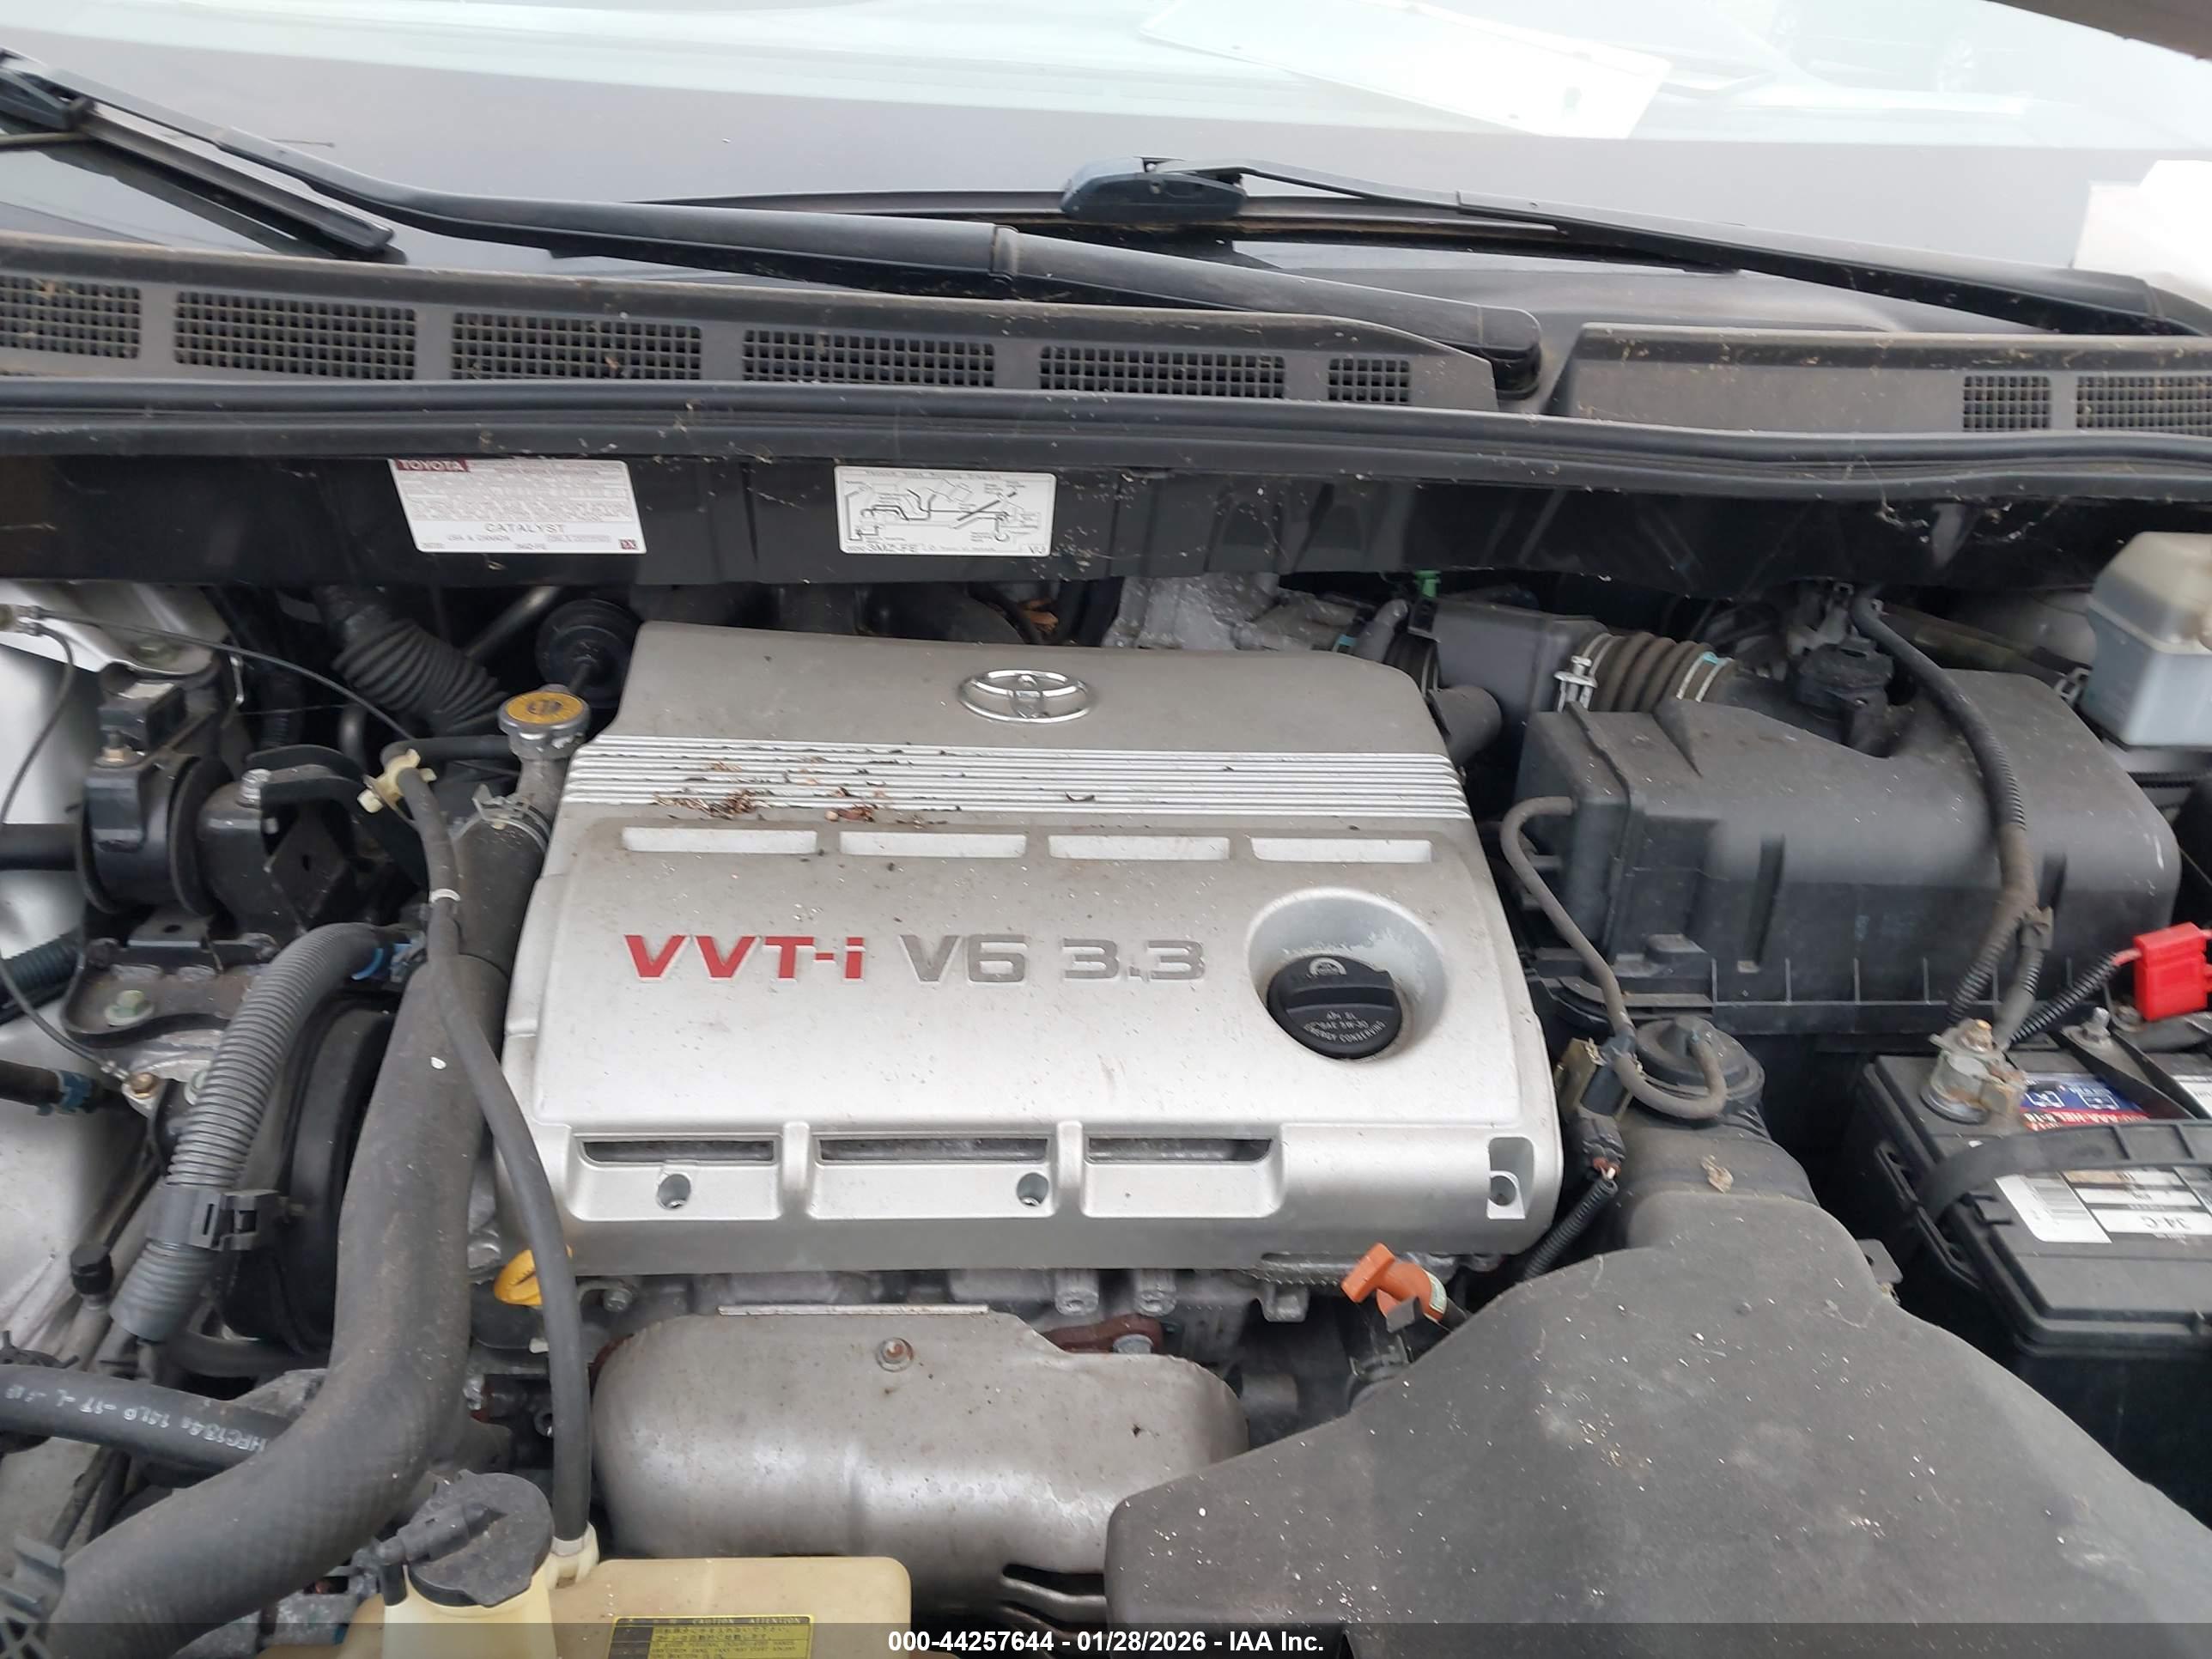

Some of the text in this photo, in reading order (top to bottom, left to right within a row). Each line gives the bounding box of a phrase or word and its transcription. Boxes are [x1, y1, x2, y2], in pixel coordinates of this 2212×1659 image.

[401, 459, 465, 471] TOYOTA
[483, 523, 565, 534] CATALYST
[623, 933, 1206, 983] VVT-i V6 3.3
